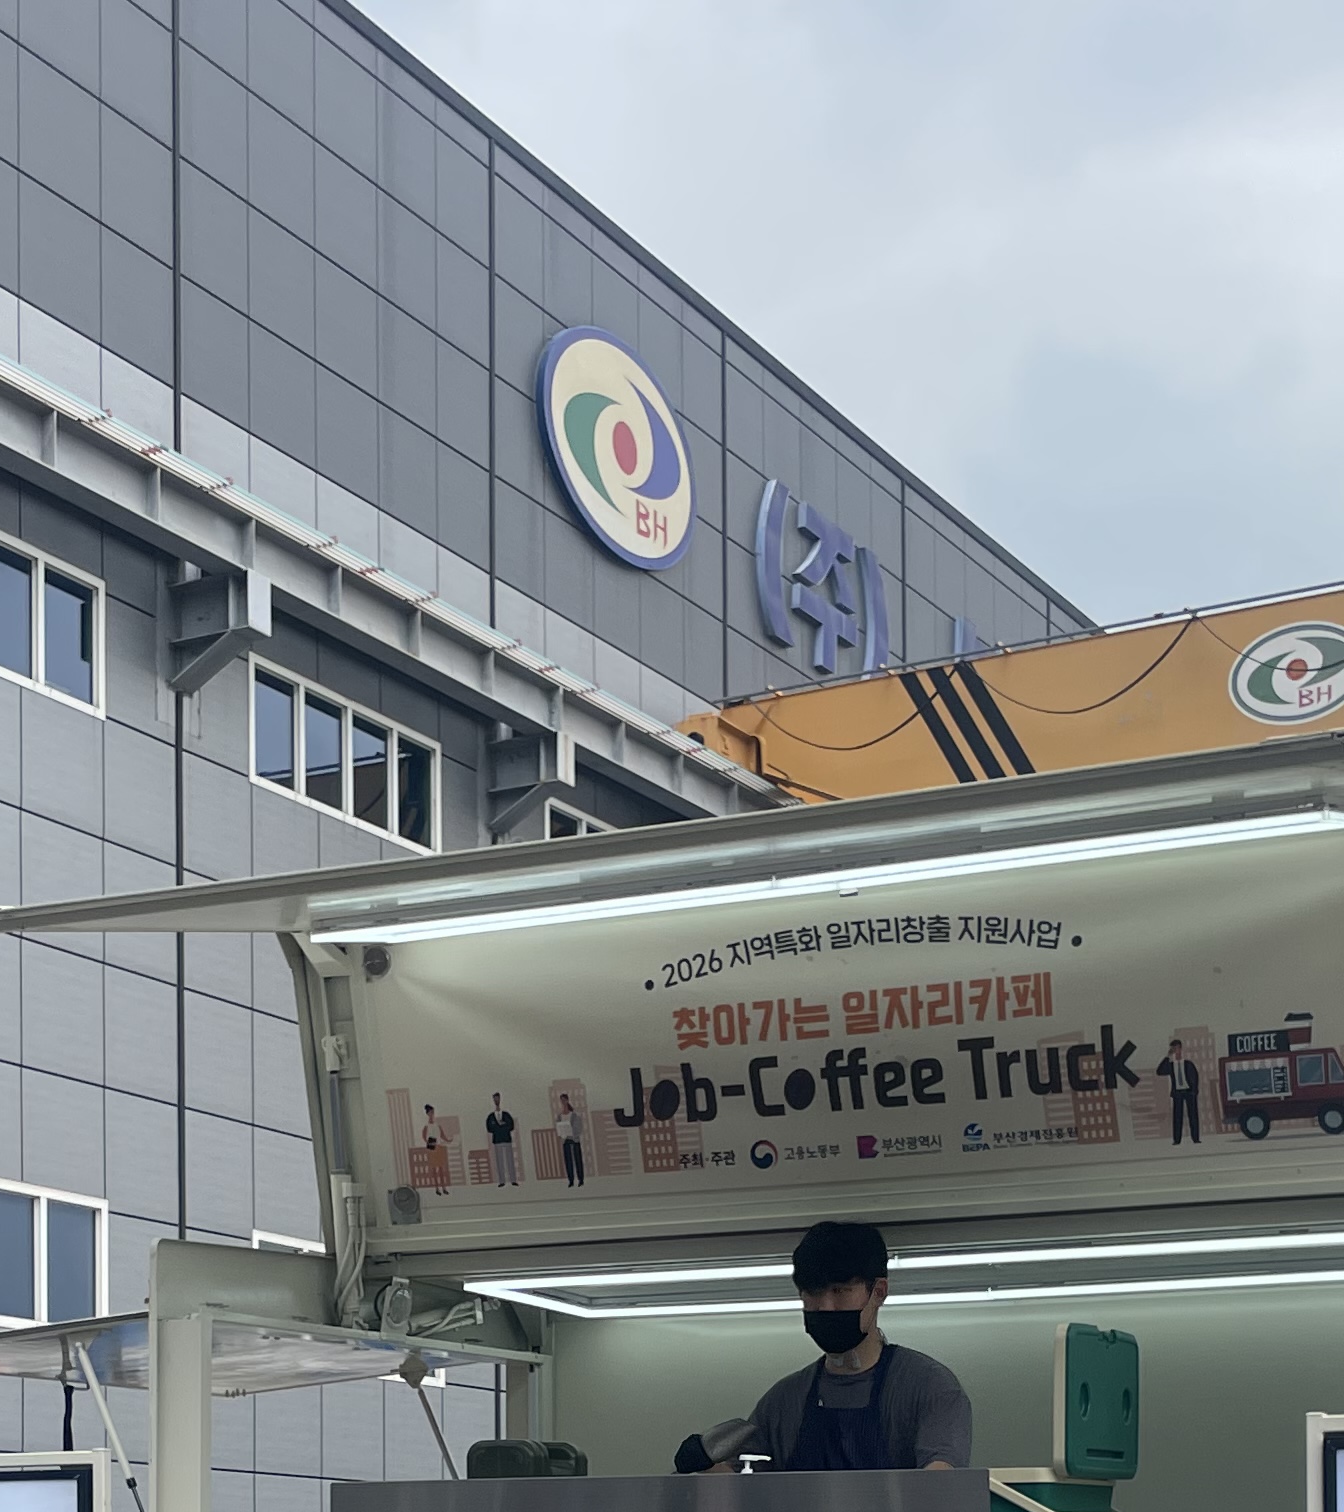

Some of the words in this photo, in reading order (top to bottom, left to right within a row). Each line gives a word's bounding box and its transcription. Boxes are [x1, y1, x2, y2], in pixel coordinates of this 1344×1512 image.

[635, 498, 667, 549] BH
[756, 478, 889, 681] (주)
[1297, 684, 1332, 710] BH
[662, 949, 724, 988] 2026
[727, 926, 821, 969] 지역특화
[826, 915, 951, 947] 일자리창출
[957, 917, 1062, 949] 지원사업
[672, 997, 830, 1051] 찾아가는
[842, 972, 1053, 1036] 일자리카페
[1236, 1033, 1277, 1053] COFFEE
[614, 1047, 946, 1128] Job-Coffee
[958, 1024, 1140, 1101] Truck
[784, 1144, 841, 1161] 고용노동부
[882, 1135, 943, 1151] 부산광역시
